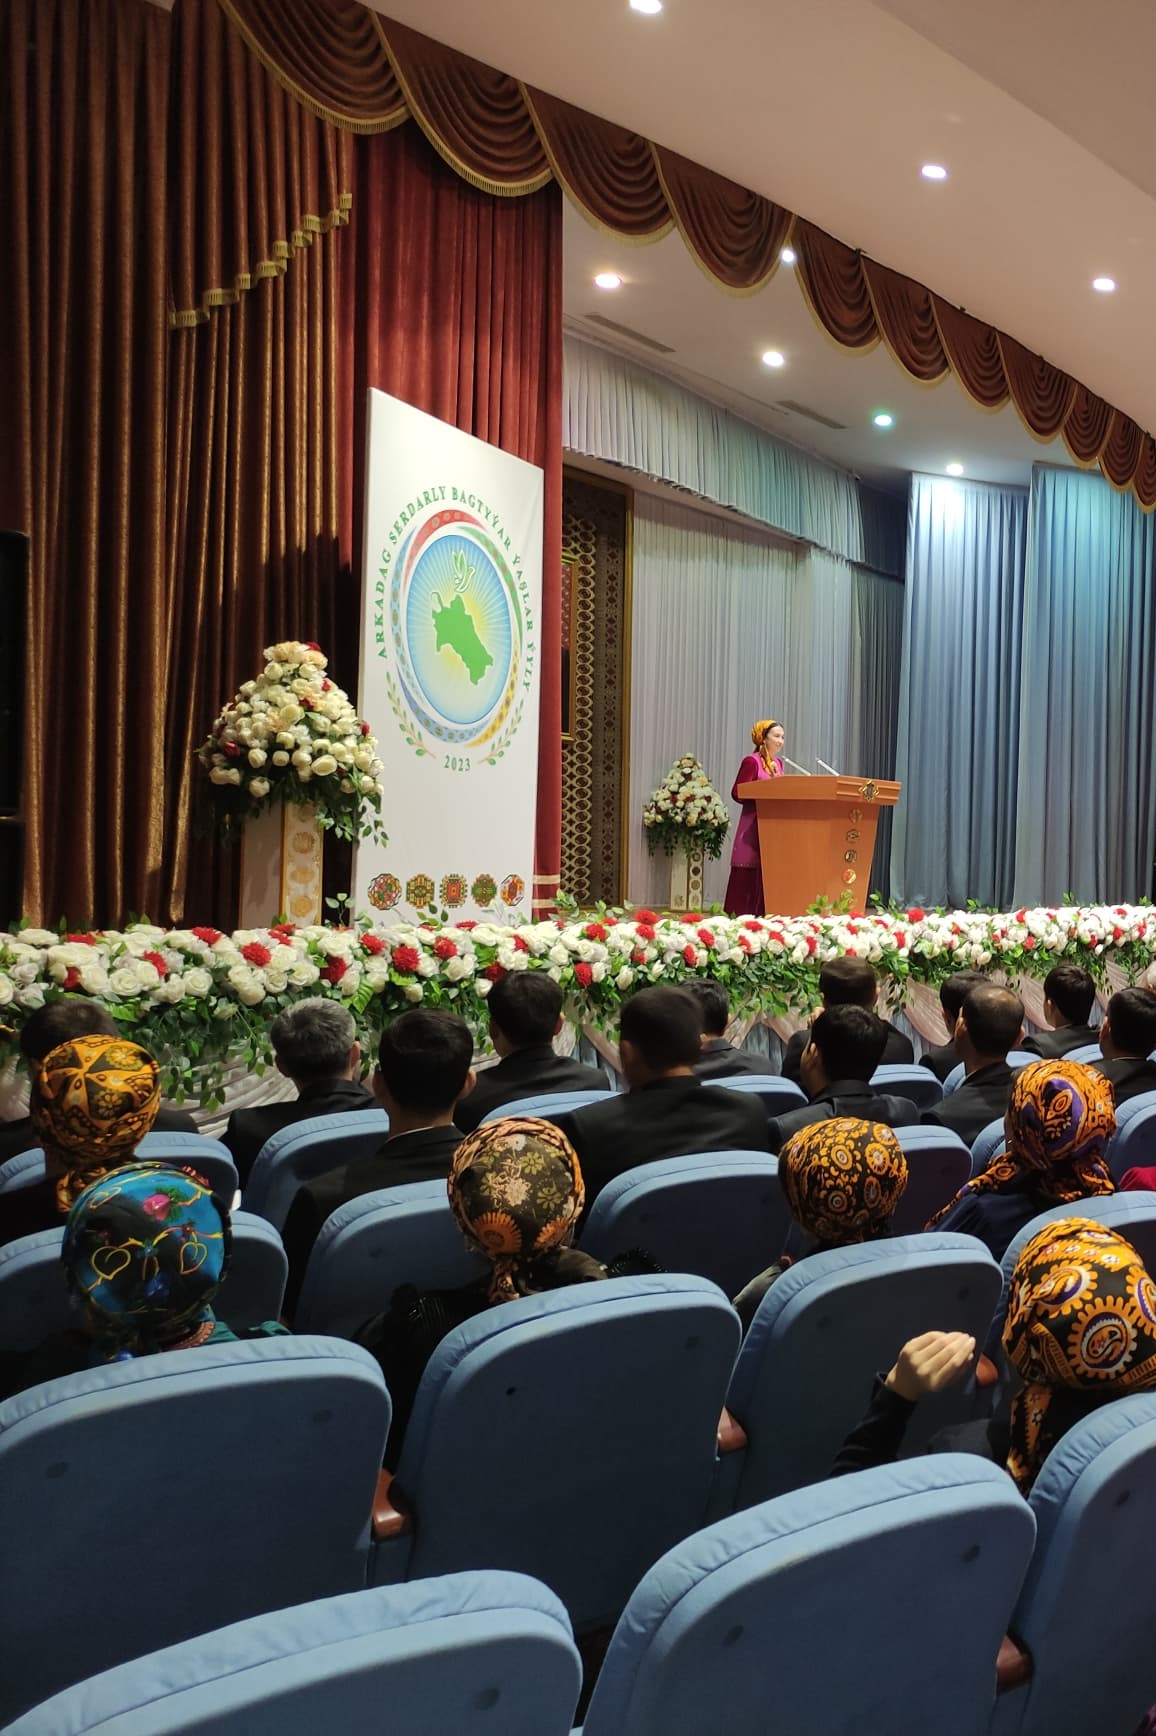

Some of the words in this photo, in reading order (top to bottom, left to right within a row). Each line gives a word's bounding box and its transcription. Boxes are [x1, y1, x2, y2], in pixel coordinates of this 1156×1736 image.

[375, 549, 393, 660] ARKADAG
[388, 485, 447, 545] SERDARLY
[444, 755, 471, 772] 2023
